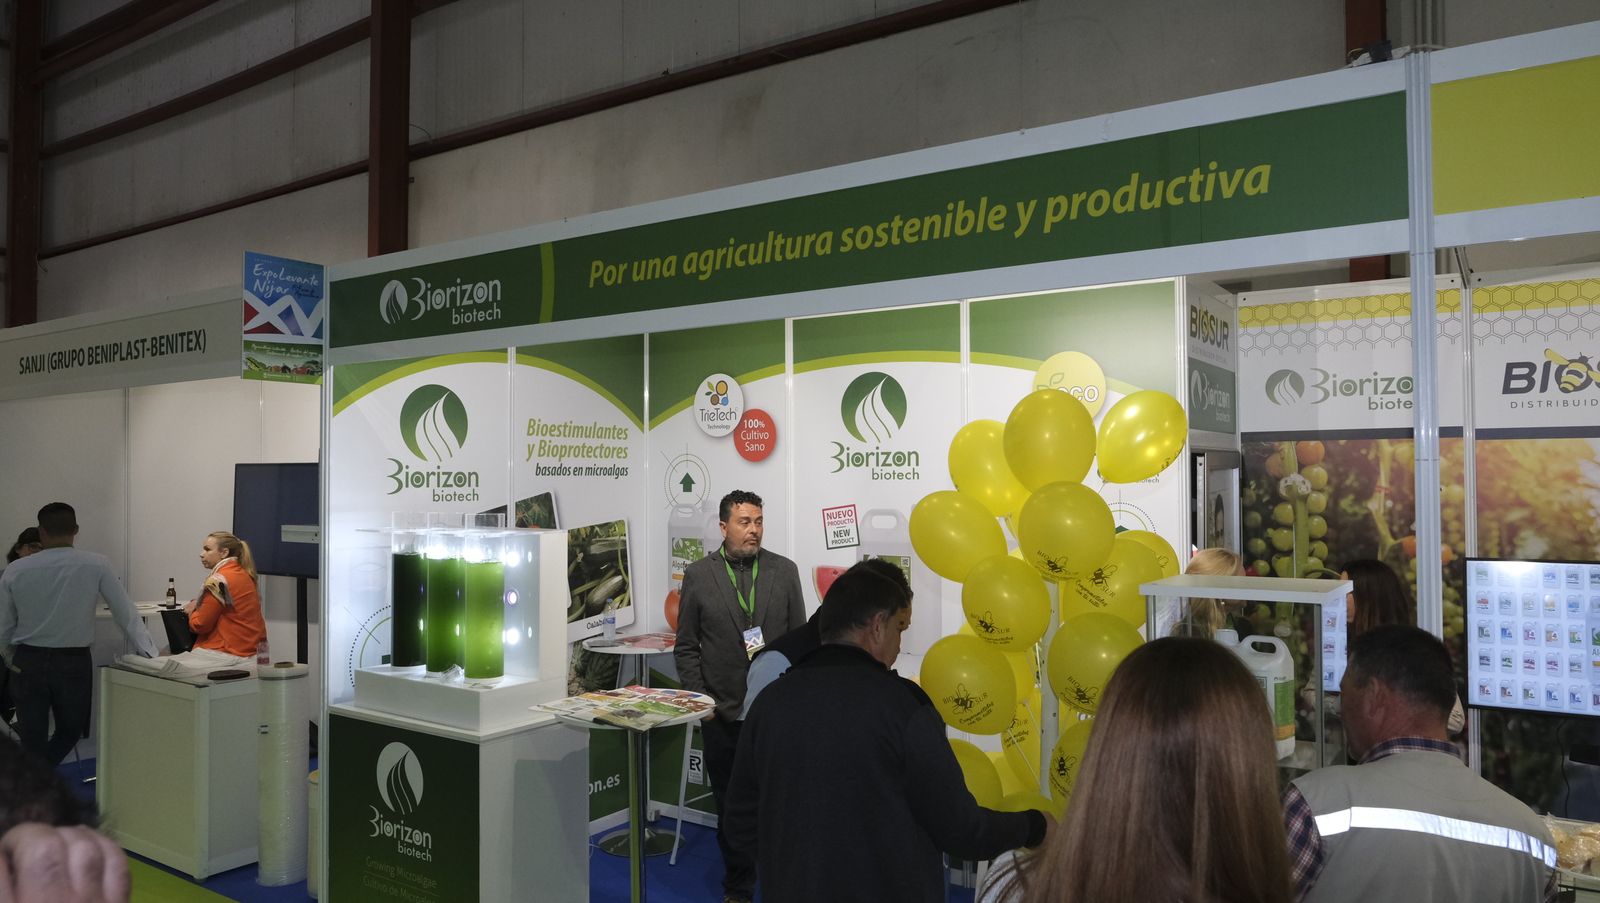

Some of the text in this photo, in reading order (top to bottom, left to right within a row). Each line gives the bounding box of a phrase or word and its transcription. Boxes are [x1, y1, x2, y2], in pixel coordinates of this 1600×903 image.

[589, 161, 1272, 289] Por una agricultura sostenible y productiva
[411, 277, 501, 321] Biorizon
[451, 306, 501, 326] biotech
[19, 329, 207, 375] SANJI (GRUPO BENIPLAST-BENITEX)
[1309, 367, 1413, 404] Biorizo
[1368, 396, 1413, 411] biote
[526, 418, 629, 441] Bioestimulantes
[707, 423, 731, 431] Technology
[743, 419, 766, 429] 100%
[740, 430, 769, 441] Cultivo
[526, 440, 629, 463] y Bioprotectores
[745, 441, 766, 452] Sano
[830, 441, 920, 474] Biorizon
[386, 457, 480, 495] Biorizon
[535, 462, 629, 479] basados en microalgas
[871, 467, 920, 481] biotech
[432, 488, 480, 503] biotech
[826, 508, 854, 521] NUEVO
[827, 518, 855, 527] PRODUCTO
[831, 537, 855, 546] PRODUCT
[833, 529, 851, 538] NEW
[369, 805, 432, 849] Biorizon
[398, 841, 432, 863] biotech
